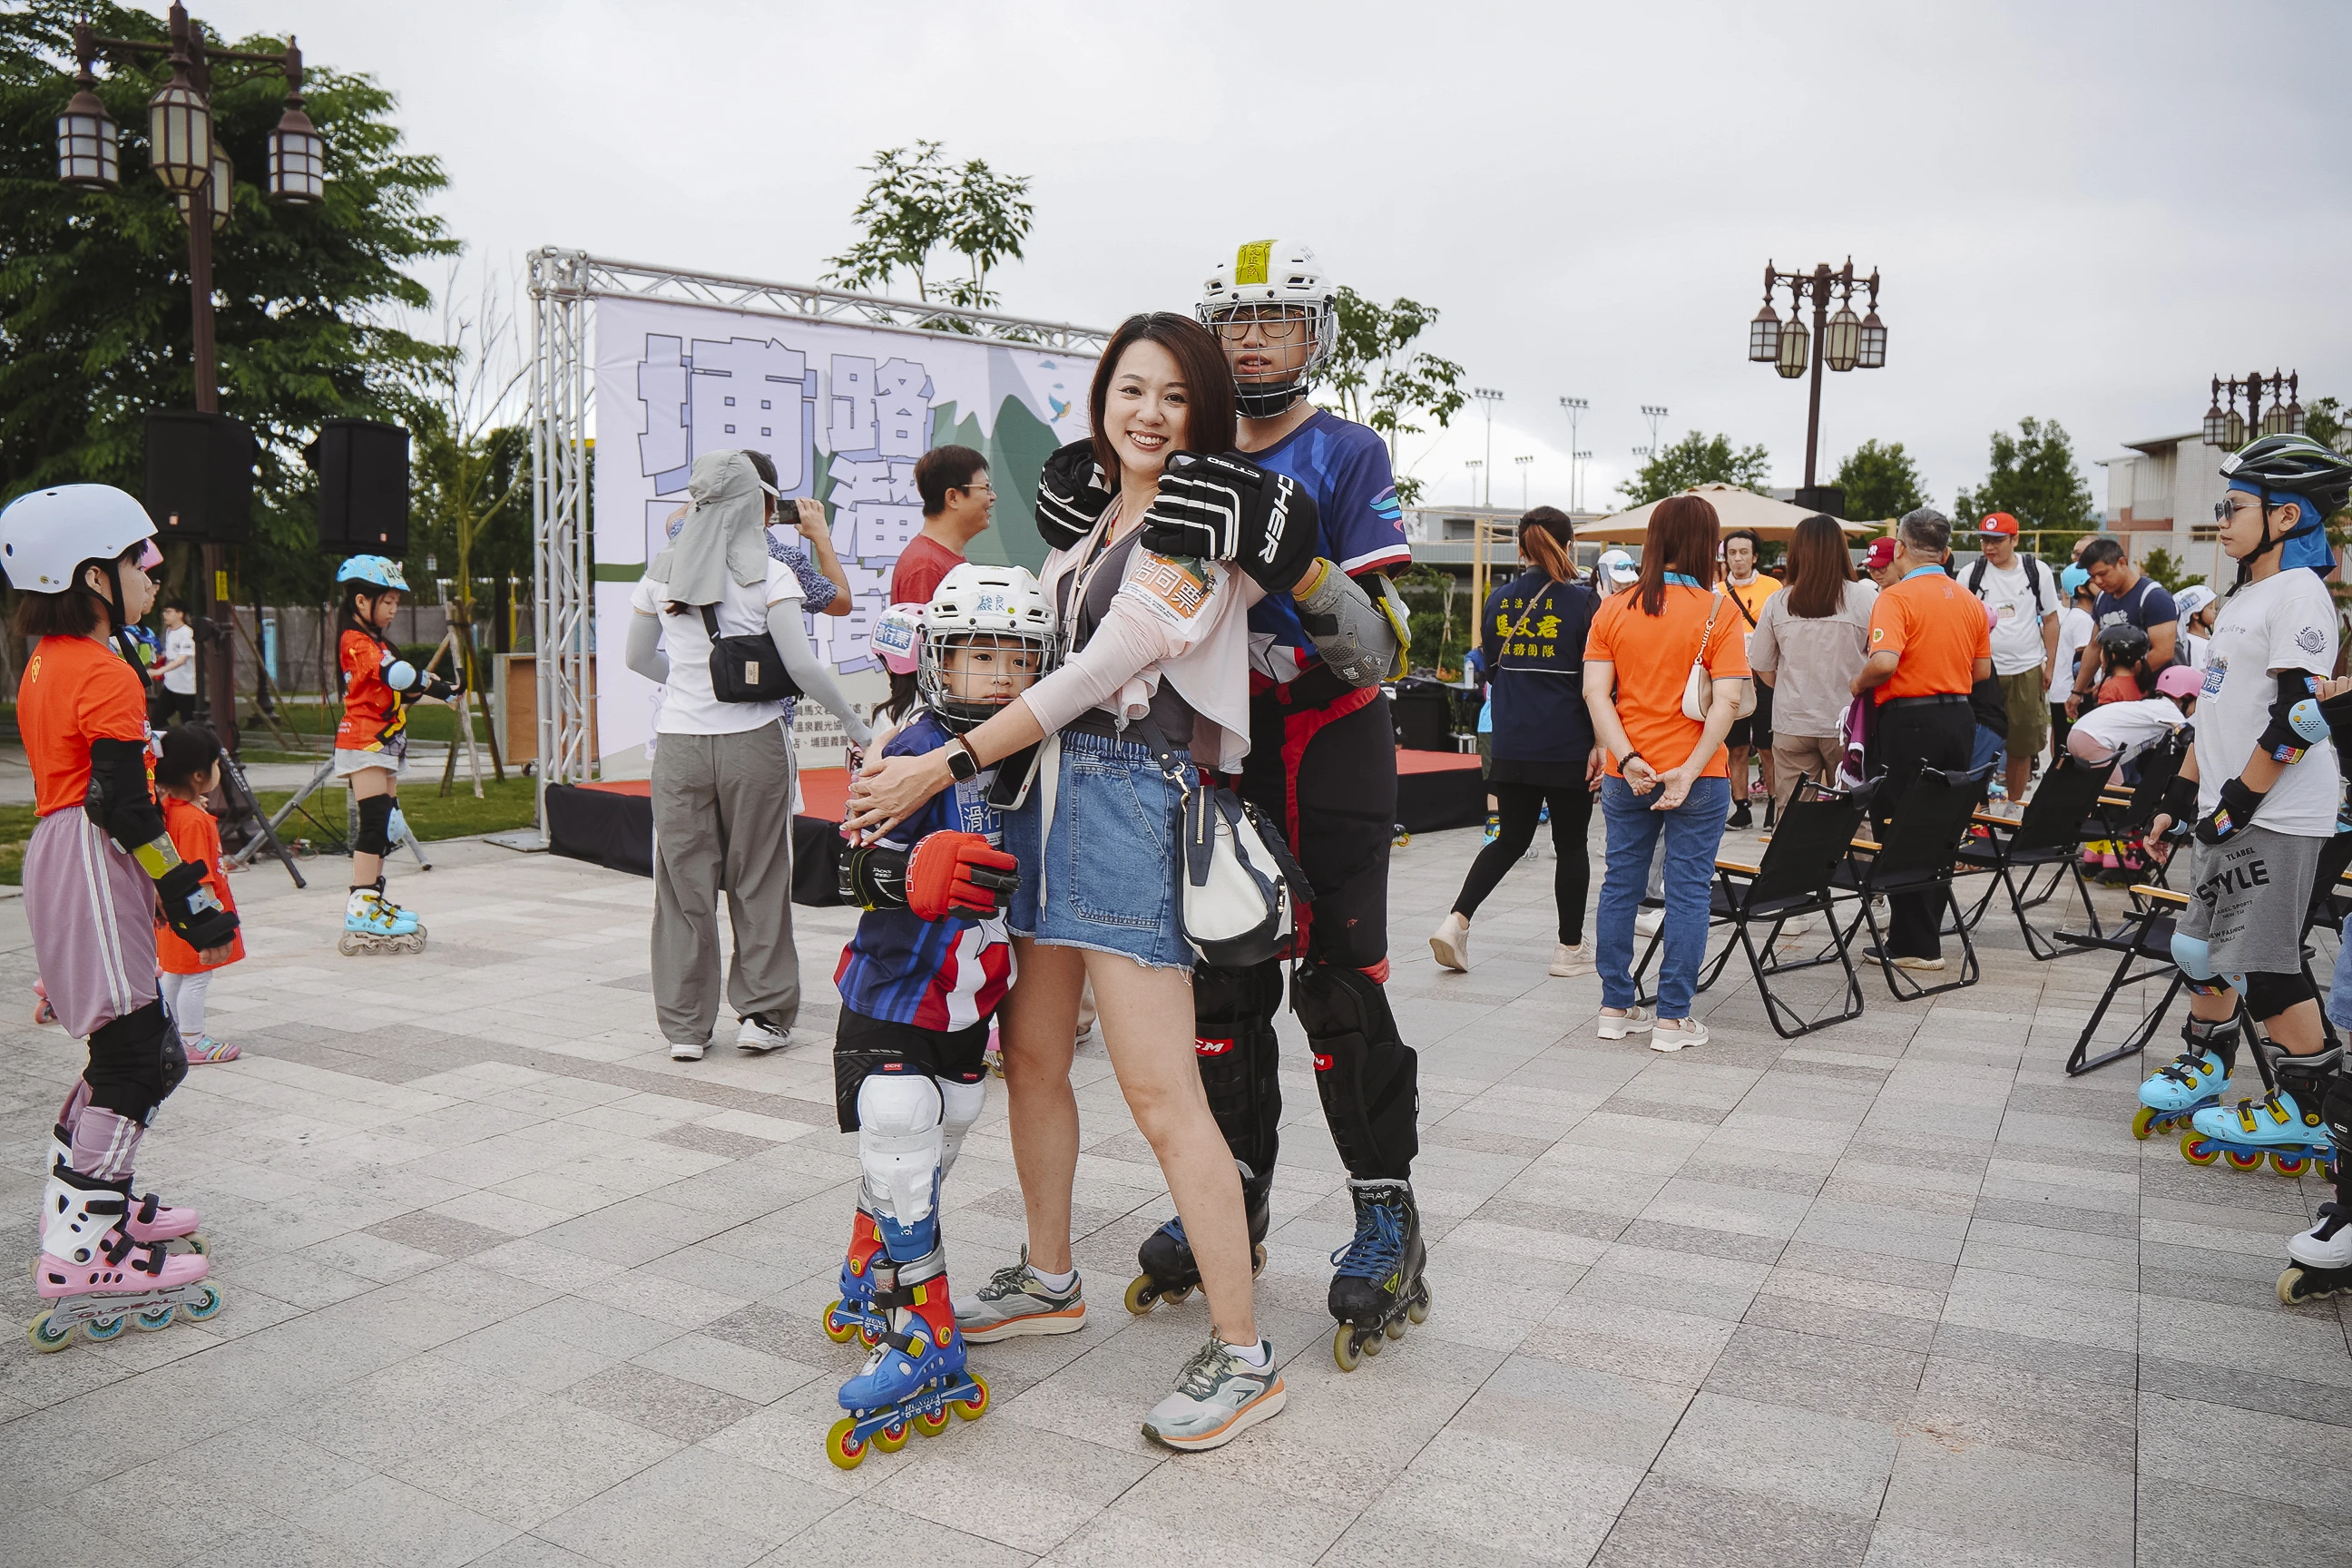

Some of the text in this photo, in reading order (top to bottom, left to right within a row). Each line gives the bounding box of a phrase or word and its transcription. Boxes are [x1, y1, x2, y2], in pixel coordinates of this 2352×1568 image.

[1259, 473, 1295, 564] CHER
[1496, 613, 1562, 638] 馬文君
[2225, 847, 2256, 861] TLABEL
[2196, 859, 2270, 907] STYLE
[1195, 1038, 1225, 1053] CM
[1358, 1191, 1392, 1200] GRAF
[864, 1317, 887, 1327] HUNG
